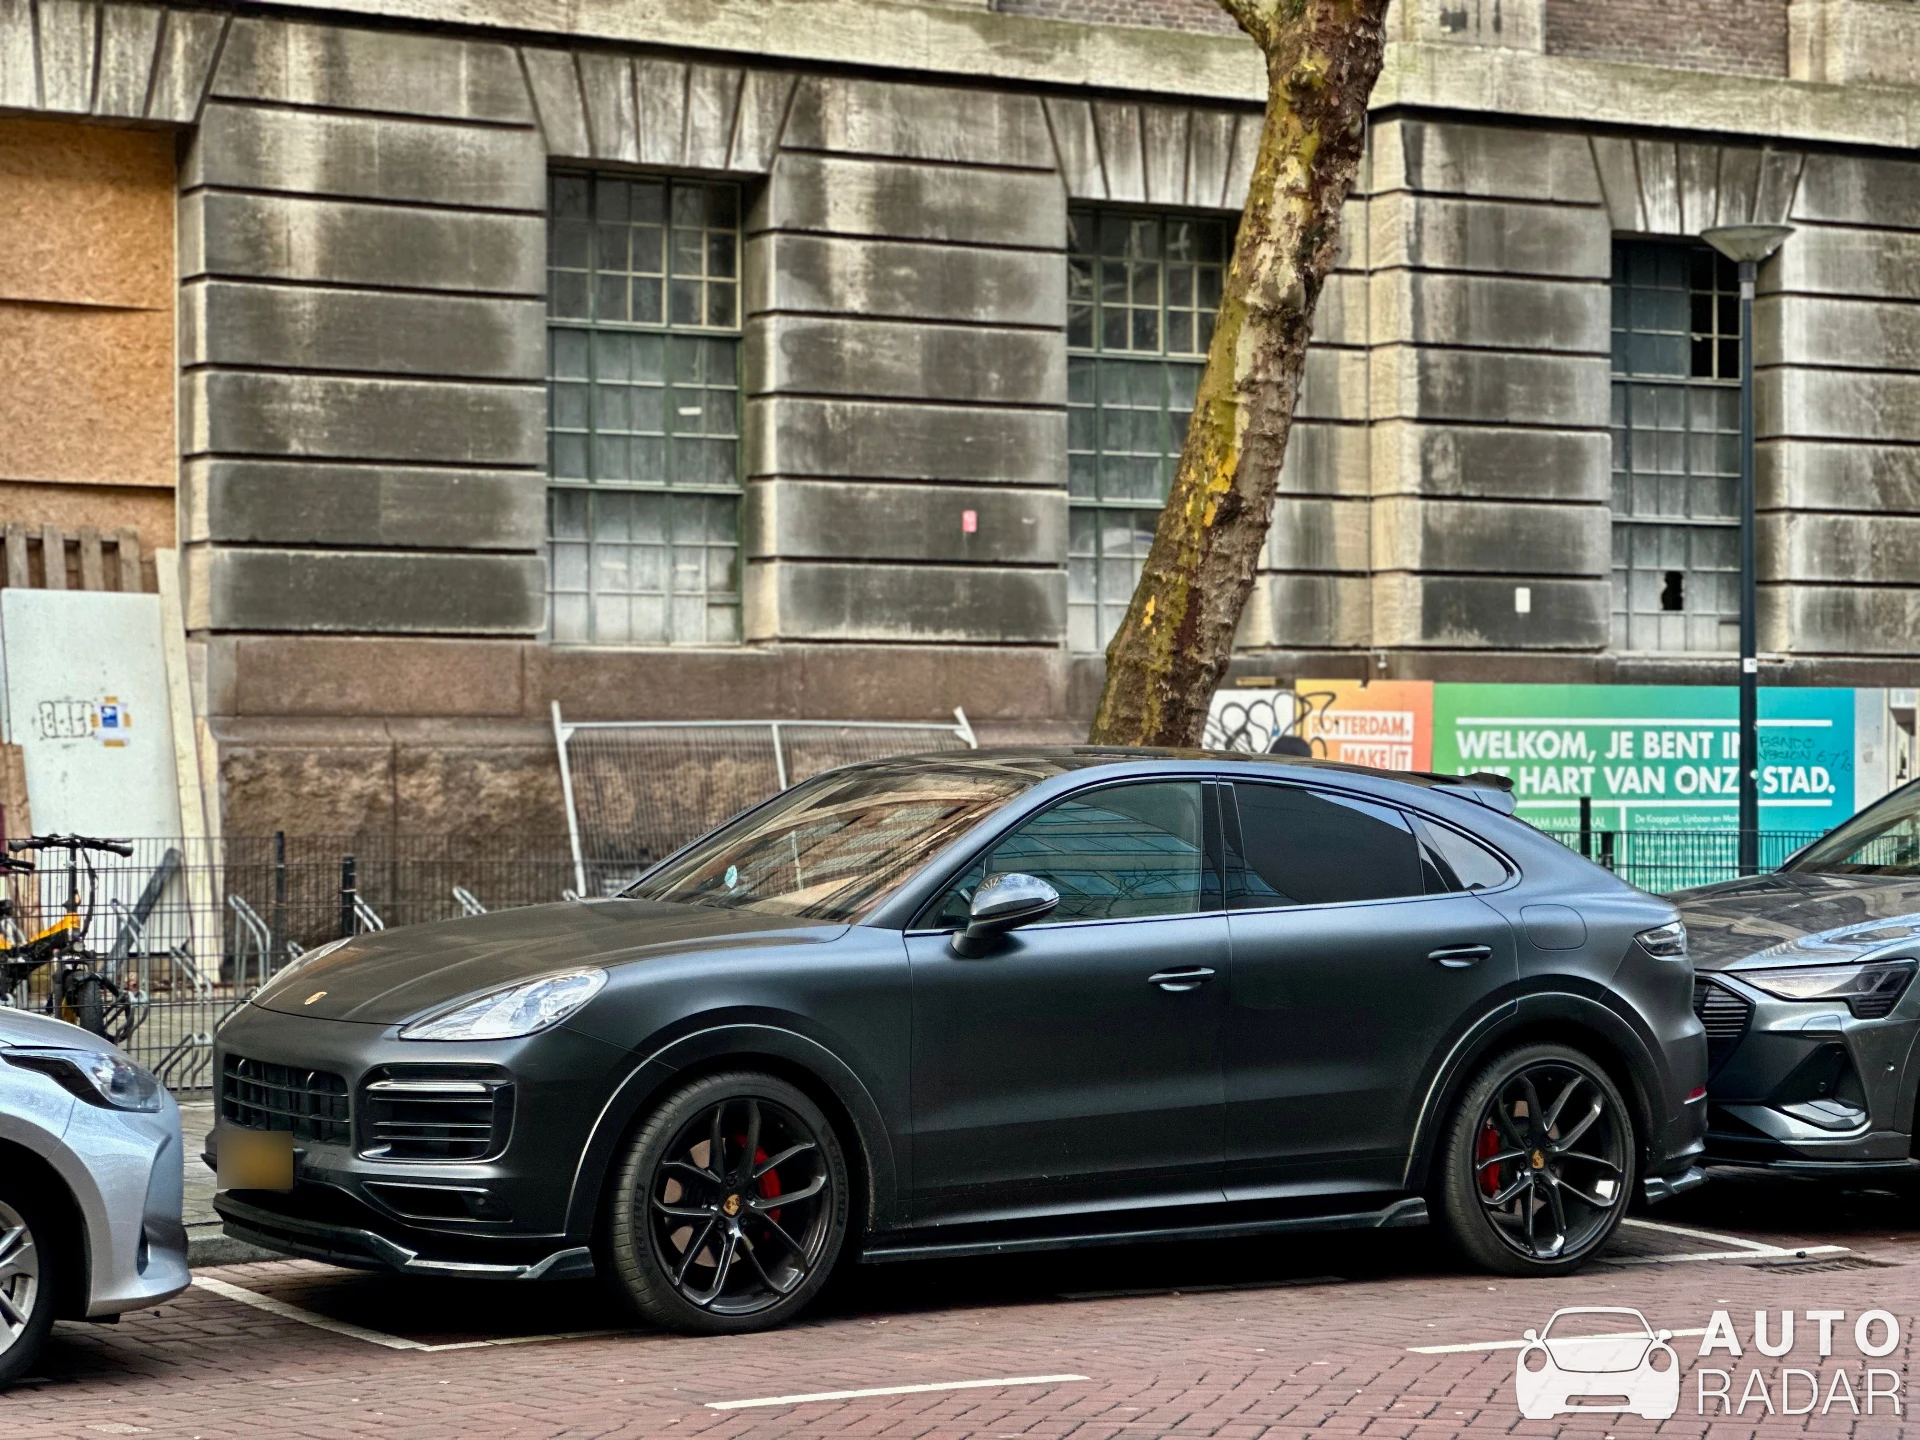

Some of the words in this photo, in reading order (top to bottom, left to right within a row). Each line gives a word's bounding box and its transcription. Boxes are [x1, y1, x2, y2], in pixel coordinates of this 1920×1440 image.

[1312, 715, 1410, 736] ROTTERDAM.
[1455, 730, 1596, 763] WELKOM,
[1605, 731, 1634, 759] JE
[1643, 731, 1714, 759] BENT
[1344, 749, 1387, 769] MAKE
[1395, 750, 1408, 770] IT
[1519, 766, 1596, 794] HART
[1603, 766, 1666, 794] VAN
[1674, 765, 1740, 794] ONZ
[1762, 765, 1836, 794] STAD.
